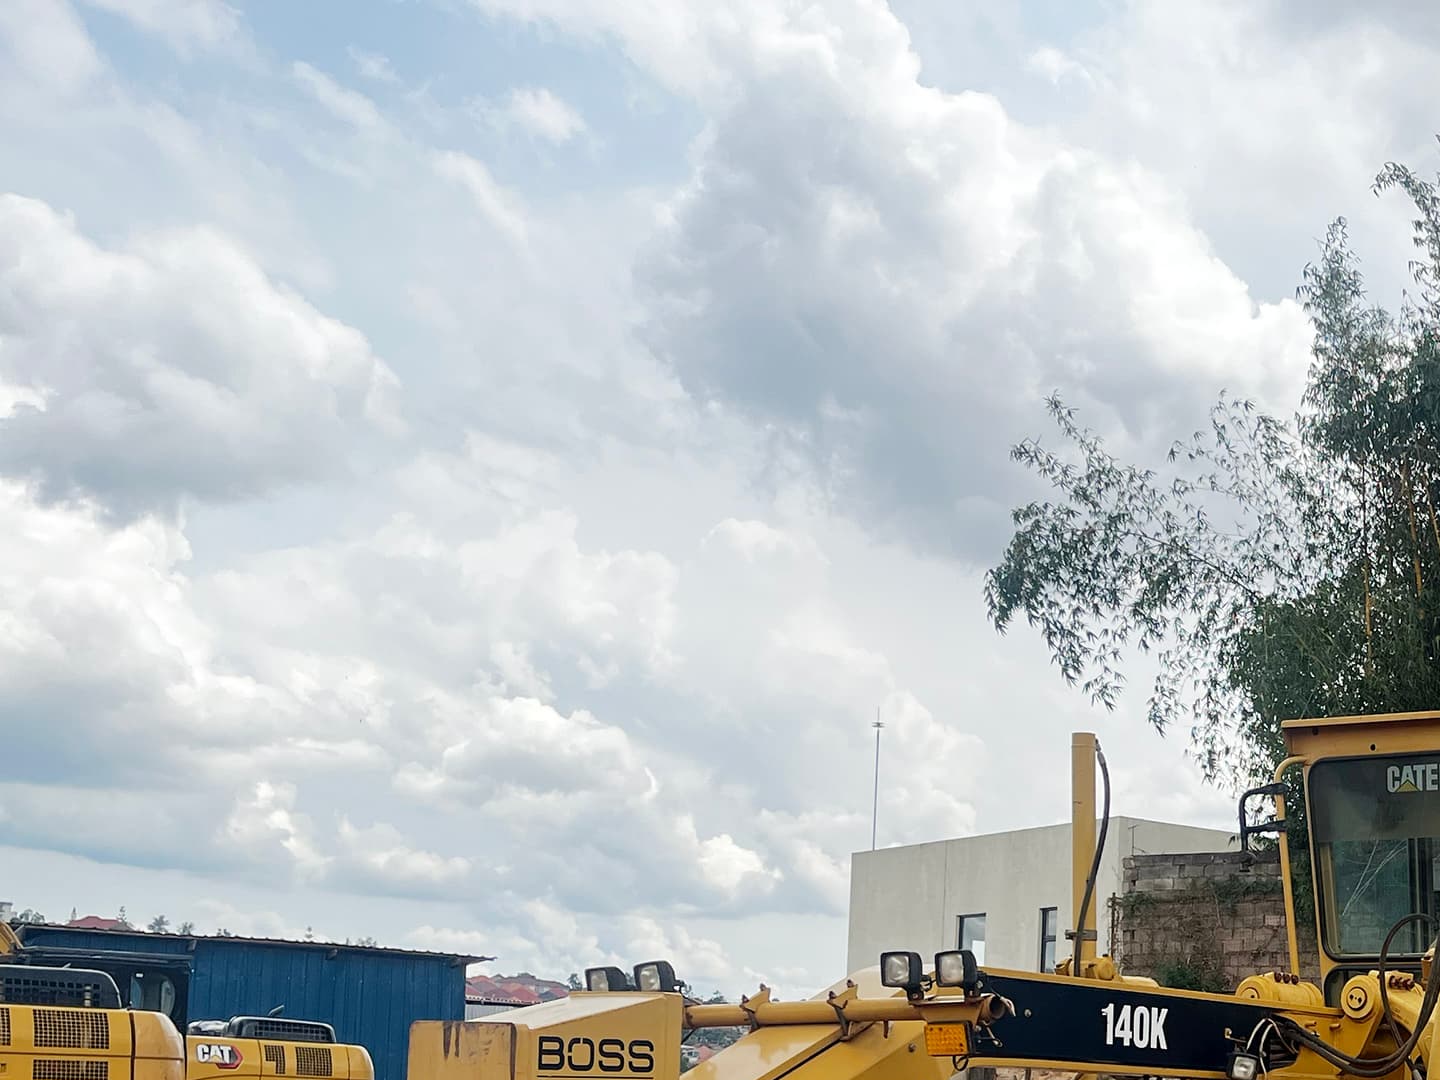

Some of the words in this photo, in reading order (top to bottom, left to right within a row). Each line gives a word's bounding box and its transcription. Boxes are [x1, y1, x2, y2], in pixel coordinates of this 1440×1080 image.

[1101, 1003, 1169, 1050] 140K
[197, 1044, 232, 1064] CAT
[537, 1036, 654, 1073] BOSS
